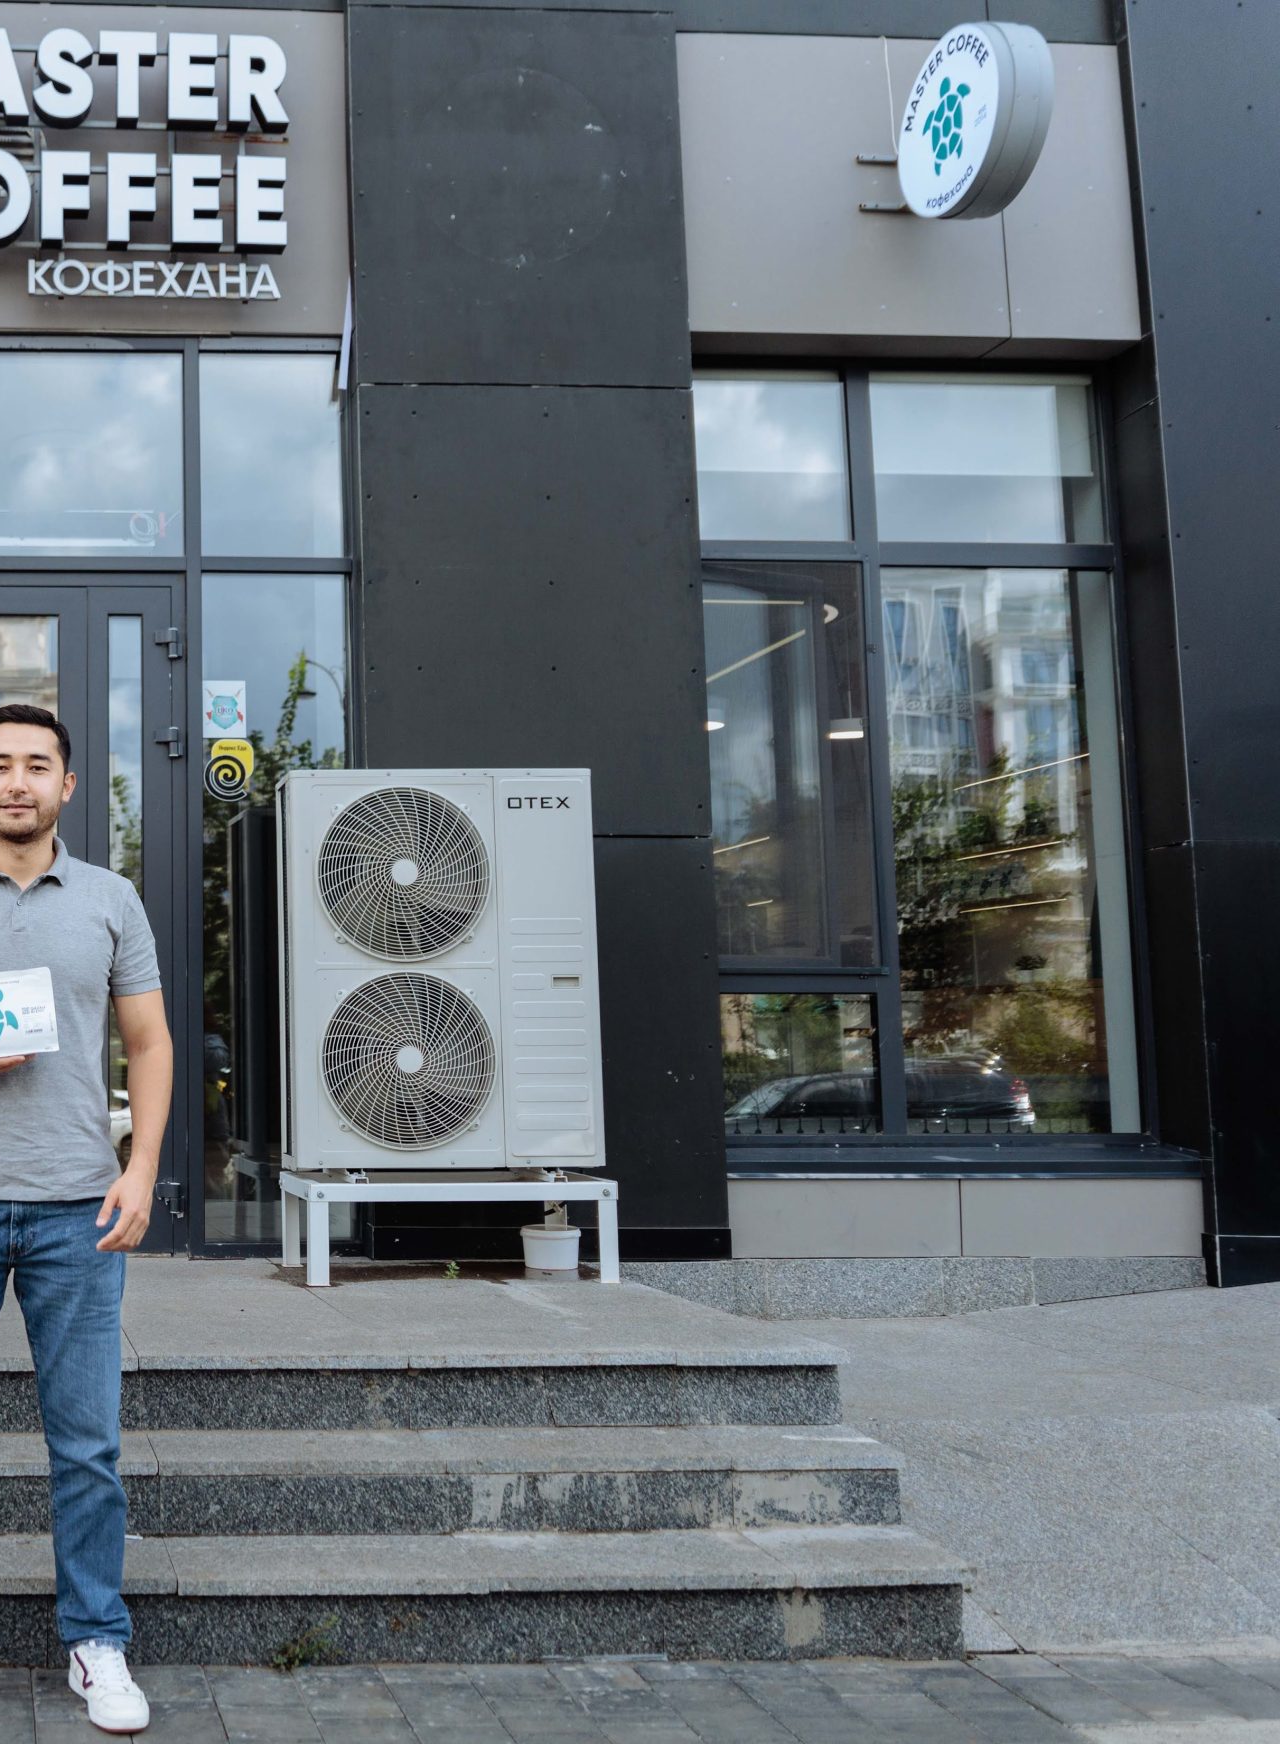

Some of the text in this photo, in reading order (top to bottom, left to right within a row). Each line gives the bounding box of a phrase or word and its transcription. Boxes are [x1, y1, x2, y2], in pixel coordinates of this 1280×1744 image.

[904, 50, 944, 132] MASTER
[946, 34, 989, 68] COFFEE
[27, 259, 281, 299] КОФЕХАНА
[507, 796, 570, 809] OTEX
